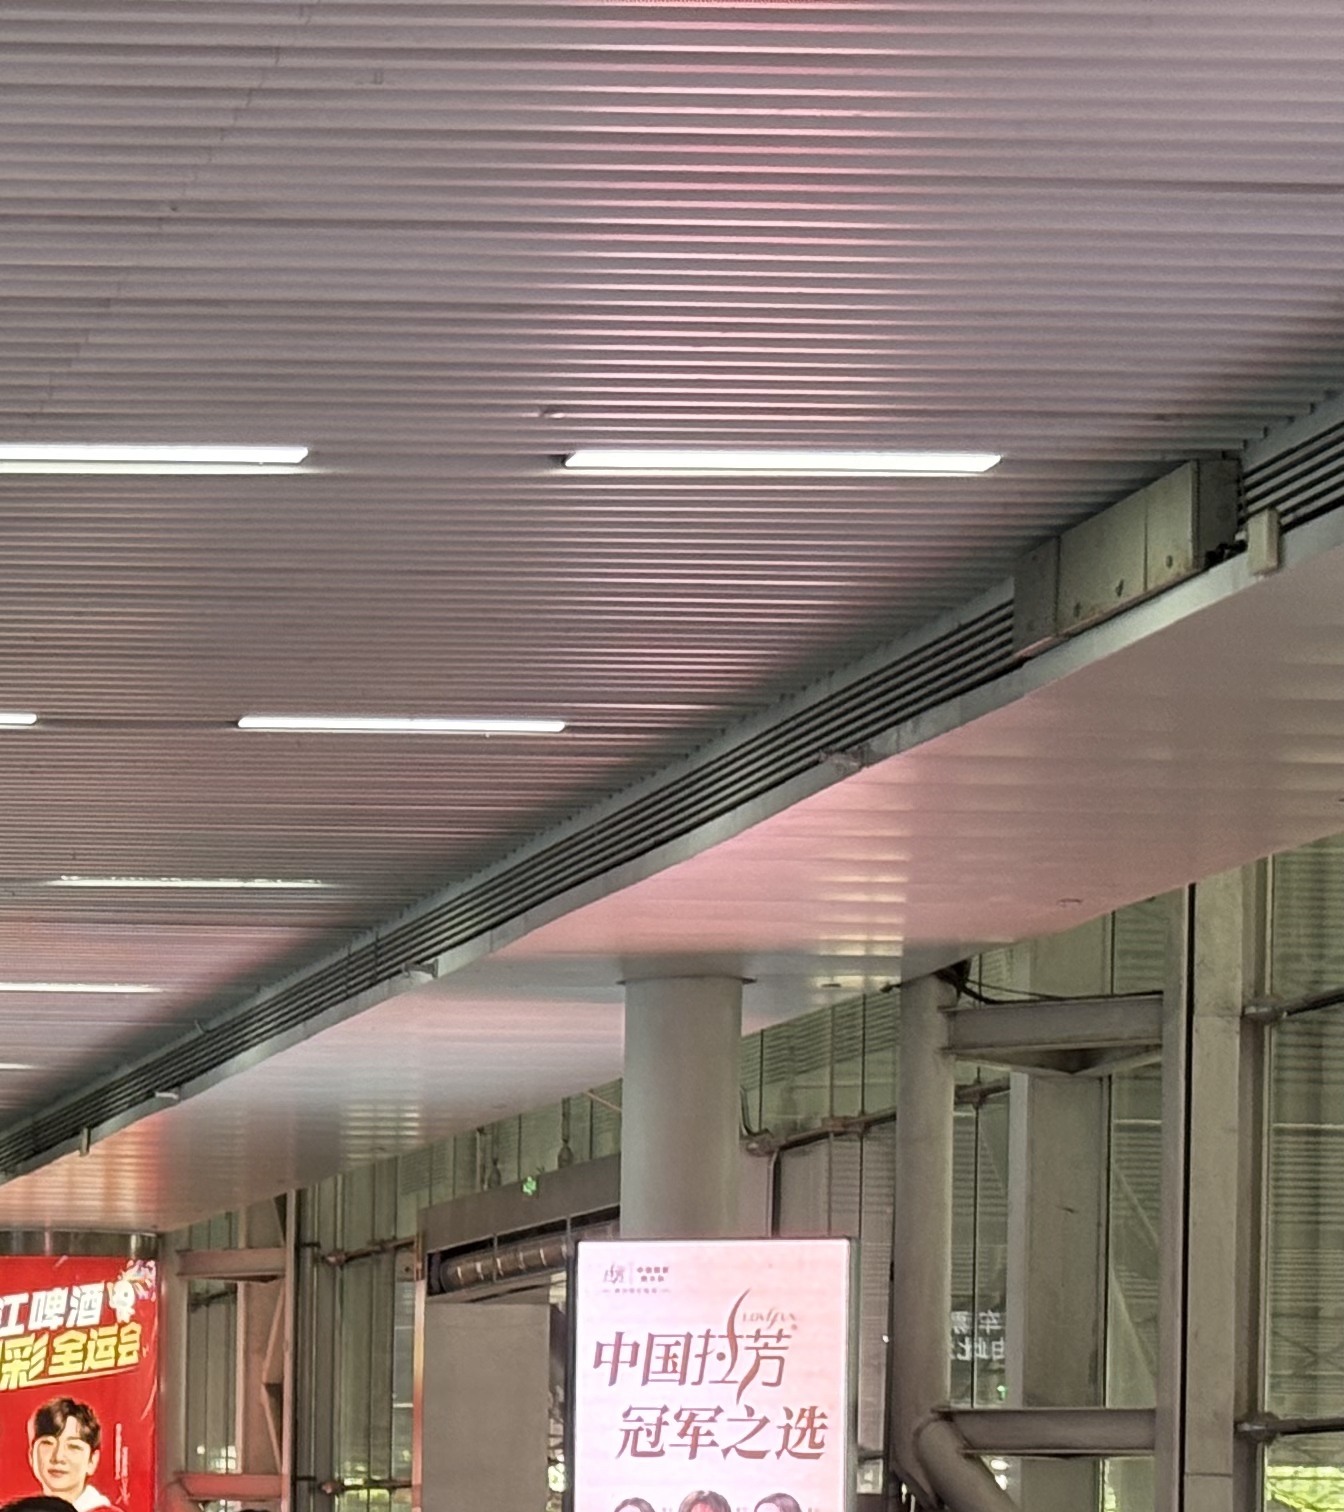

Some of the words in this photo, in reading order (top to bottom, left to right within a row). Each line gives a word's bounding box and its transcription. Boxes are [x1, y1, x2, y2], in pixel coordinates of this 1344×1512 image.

[593, 1298, 792, 1402] 中国拉芳
[615, 1403, 829, 1461] 冠军之选
